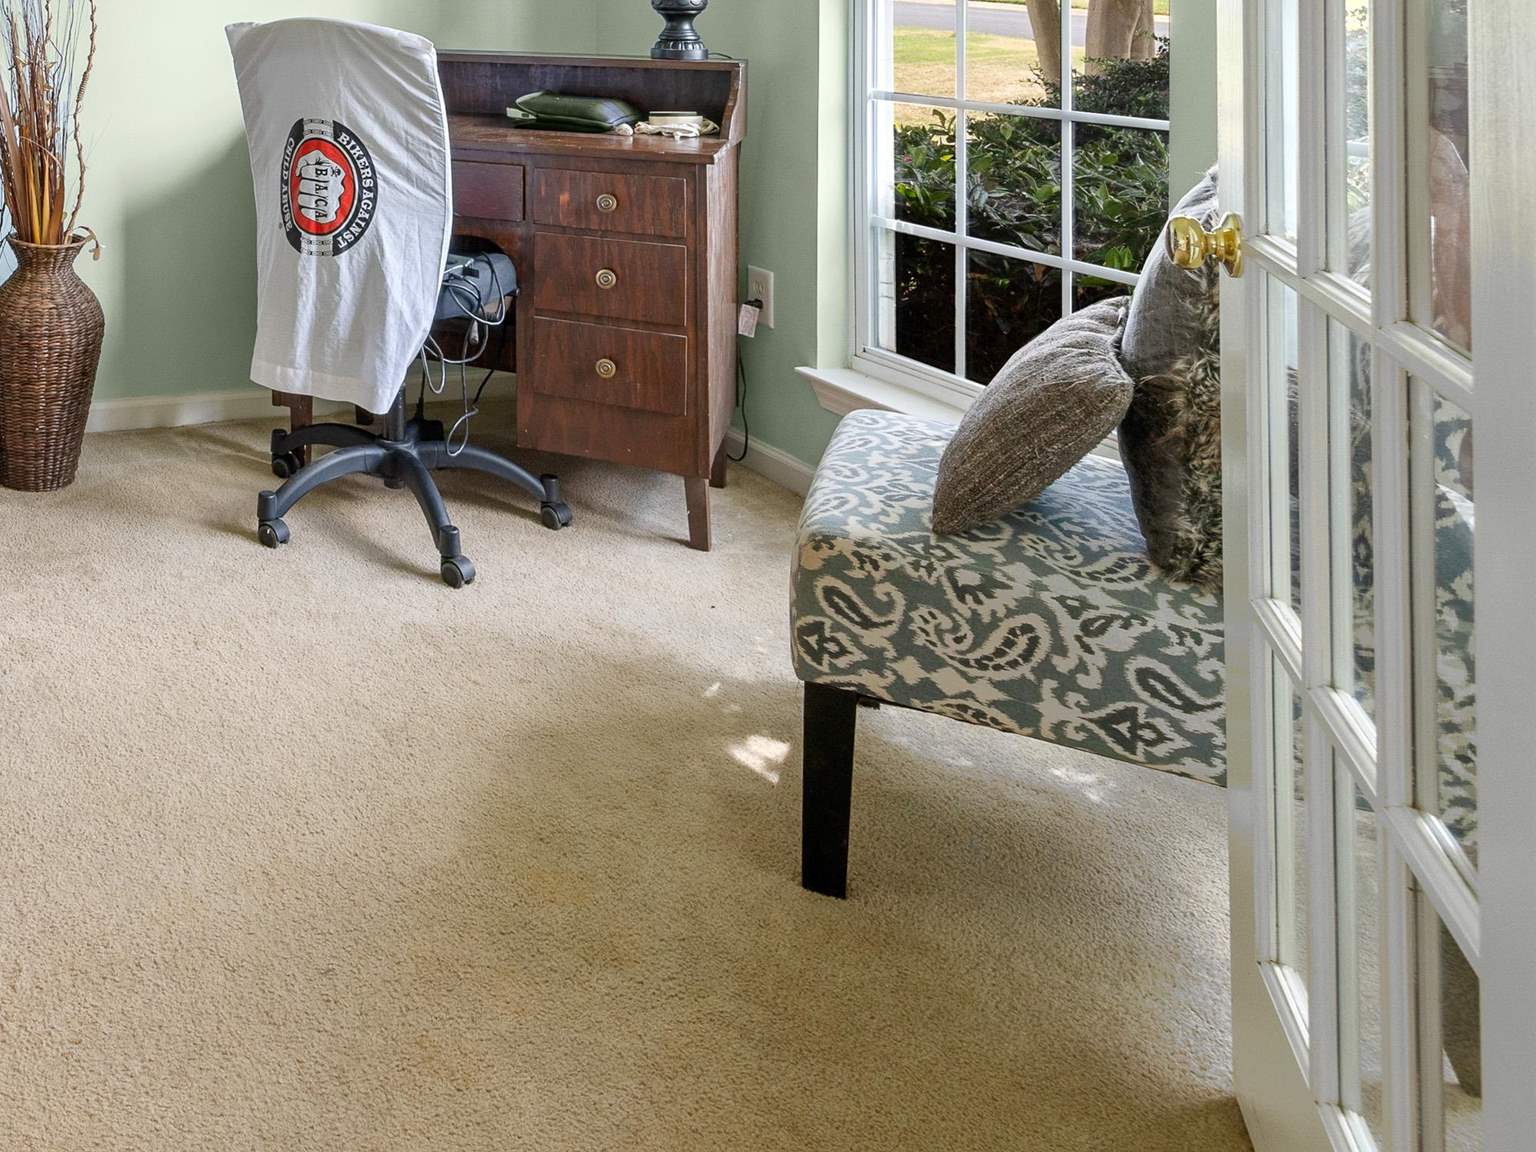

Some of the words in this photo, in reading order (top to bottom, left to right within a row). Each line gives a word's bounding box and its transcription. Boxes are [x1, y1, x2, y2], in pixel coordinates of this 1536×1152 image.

[282, 137, 296, 181] CHILD
[337, 132, 374, 187] BIKERS
[337, 190, 374, 248] AGAINST
